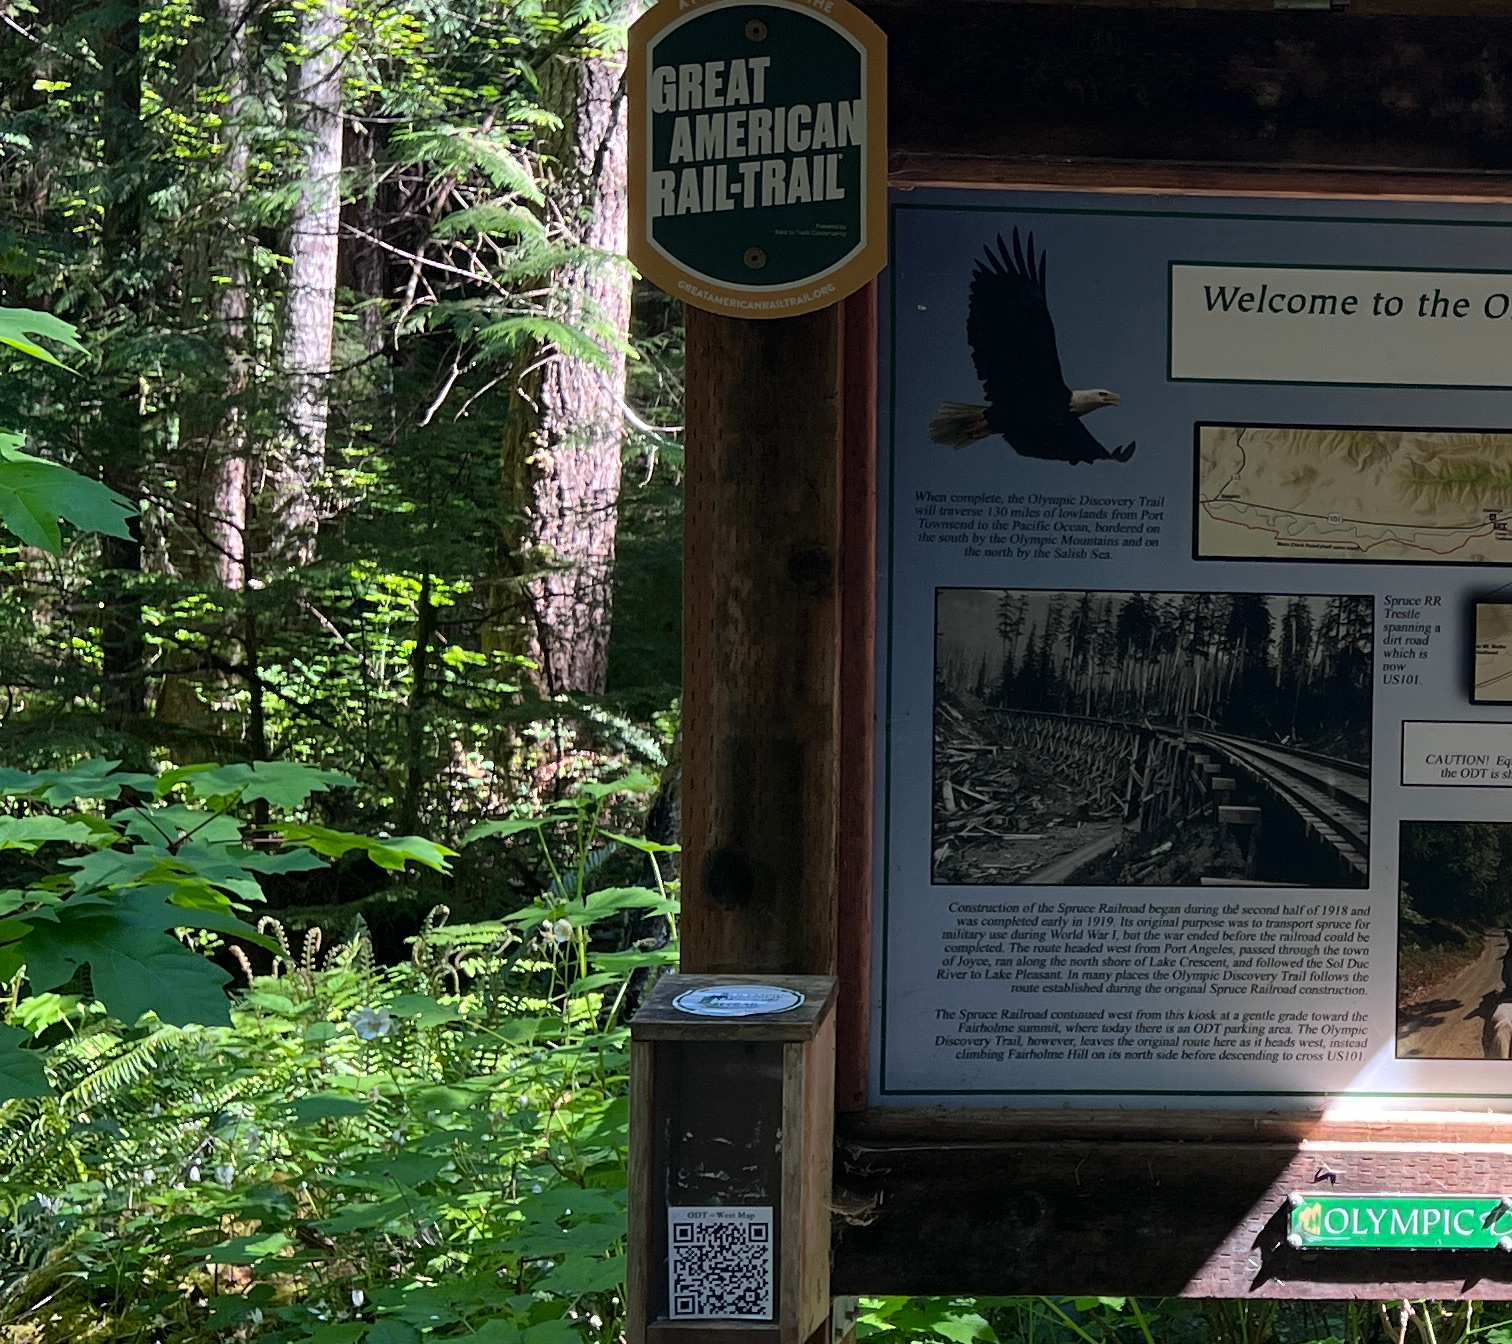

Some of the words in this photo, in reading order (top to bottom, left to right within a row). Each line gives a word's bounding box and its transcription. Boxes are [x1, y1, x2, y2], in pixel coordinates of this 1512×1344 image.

[679, 0, 689, 10] A
[651, 55, 771, 114] GREAT
[669, 98, 863, 165] AMERICAN
[677, 280, 837, 310] GREATAMERICANRAILTRAIL.ORG
[1203, 283, 1359, 317] Welcome
[1372, 291, 1404, 317] to
[1417, 288, 1471, 319] the
[915, 491, 946, 503] When
[948, 492, 1003, 507] complete,
[1007, 493, 1024, 504] the
[1027, 494, 1075, 508] Olympic
[1079, 495, 1136, 509] Discovery
[1136, 496, 1164, 507] Trail
[1383, 595, 1422, 608] Spruce
[1423, 595, 1442, 607] RR
[1384, 608, 1421, 619] Trestle
[1382, 623, 1432, 635] spanning
[1434, 624, 1441, 633] a
[1382, 635, 1402, 646] dirt
[1405, 635, 1430, 646] road
[1384, 648, 1416, 659] which
[1419, 650, 1428, 659] is
[1382, 663, 1407, 672] now
[1425, 755, 1489, 766] CAUTION!
[1440, 768, 1457, 778] the
[1460, 768, 1488, 778] ODT
[1490, 768, 1499, 779] is
[948, 902, 1019, 914] Construction
[1022, 903, 1035, 914] of
[1037, 903, 1054, 914] the
[1057, 903, 1095, 917] Spruce
[1098, 904, 1145, 914] Railroad
[1148, 904, 1180, 918] began
[1183, 904, 1218, 918] during
[1222, 904, 1239, 915] the
[1241, 905, 1279, 915] second
[1282, 905, 1306, 916] half
[1306, 905, 1321, 916] of
[1321, 905, 1348, 916] 1918
[1350, 906, 1370, 916] and
[980, 916, 1038, 930] completed
[1040, 916, 1068, 930] early
[1071, 917, 1082, 927] in
[1120, 917, 1133, 928] Its
[1136, 917, 1178, 931] original
[1181, 921, 1224, 931] purpose
[1251, 918, 1262, 928] to
[1265, 918, 1313, 932] transport
[1315, 922, 1351, 932] spruce
[1354, 919, 1370, 929] for
[687, 1211, 708, 1219] ODT
[716, 1211, 736, 1219] West
[737, 1211, 756, 1220] Map
[1323, 1207, 1476, 1237] OLYMPIC
